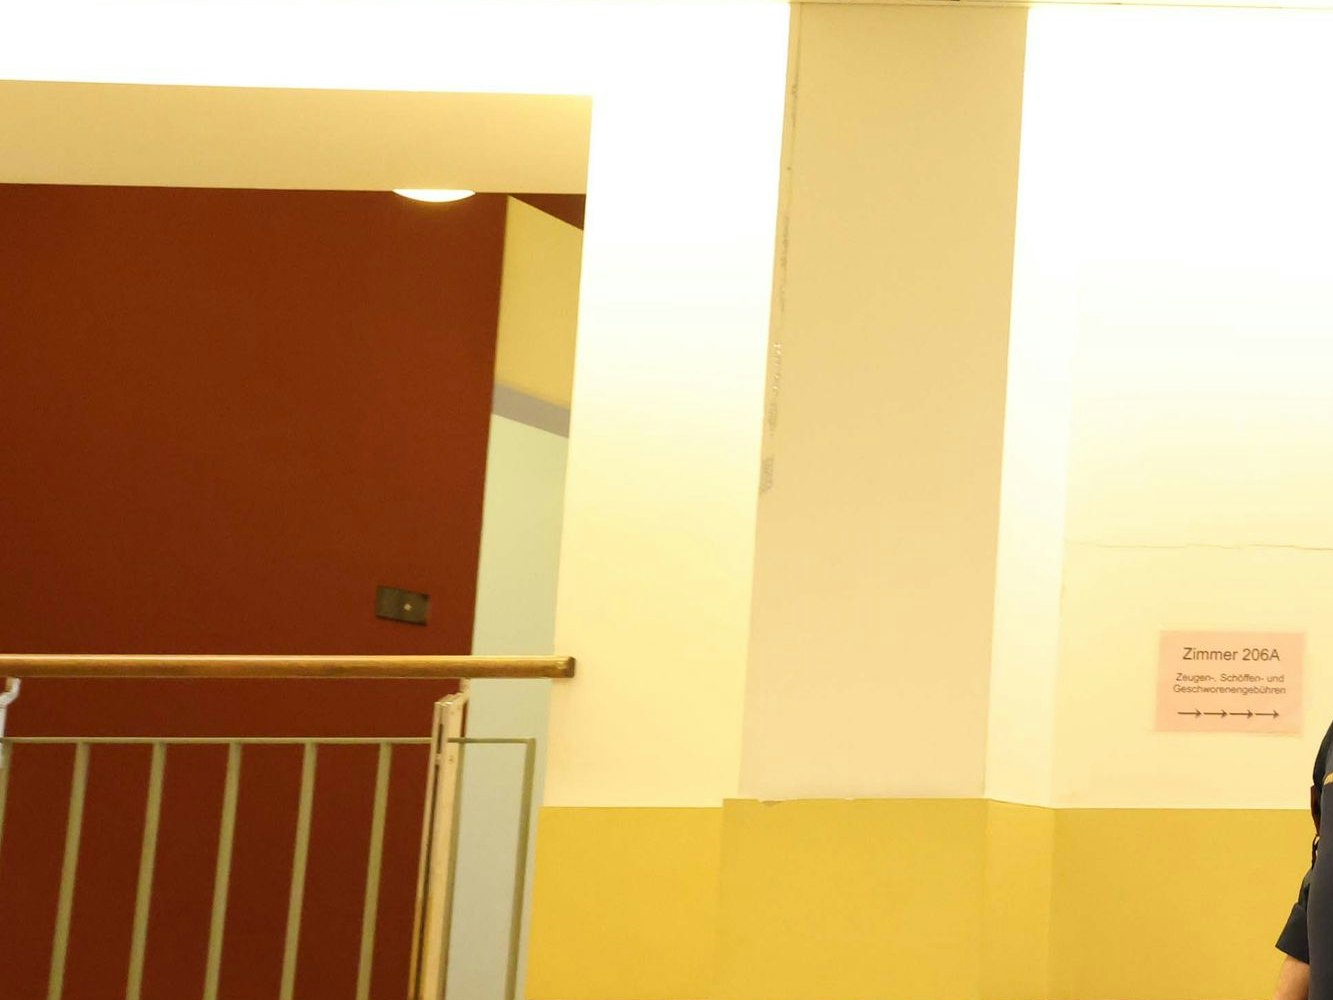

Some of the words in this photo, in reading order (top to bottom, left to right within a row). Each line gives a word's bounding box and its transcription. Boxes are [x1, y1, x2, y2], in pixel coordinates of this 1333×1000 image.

[1182, 647, 1238, 661] Zimmer
[1242, 648, 1280, 662] 206A
[1220, 673, 1264, 683] Schöffen-
[1266, 674, 1285, 683] und
[1173, 684, 1286, 696] Geschworenengebühren
